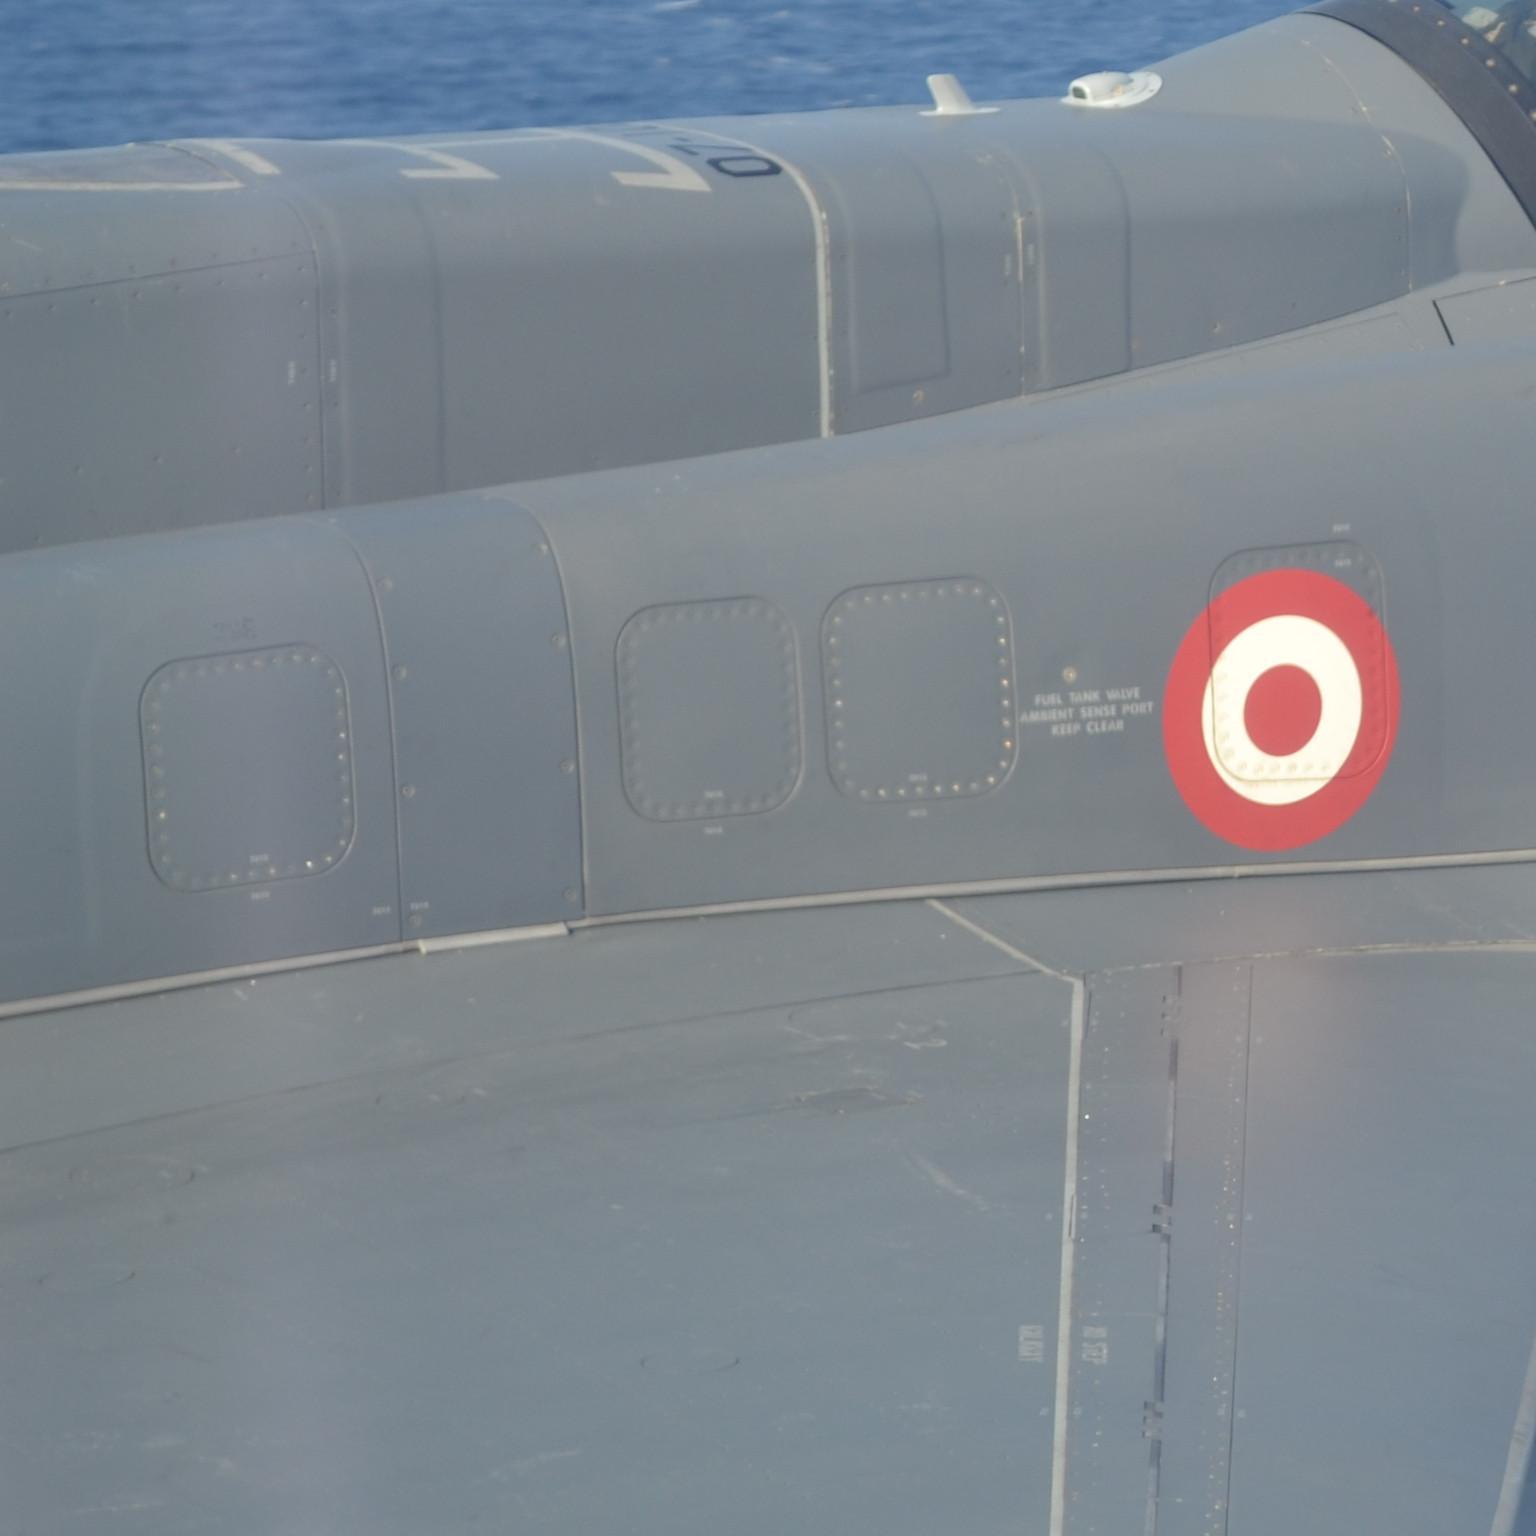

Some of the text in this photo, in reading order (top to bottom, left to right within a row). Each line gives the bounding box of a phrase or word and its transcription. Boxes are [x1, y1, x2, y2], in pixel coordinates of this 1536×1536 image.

[1034, 686, 1142, 706] FUEL TANK VALVE
[1020, 701, 1154, 722] AMBIENT SENSE PORT
[1051, 719, 1125, 736] KEEP CLEAR
